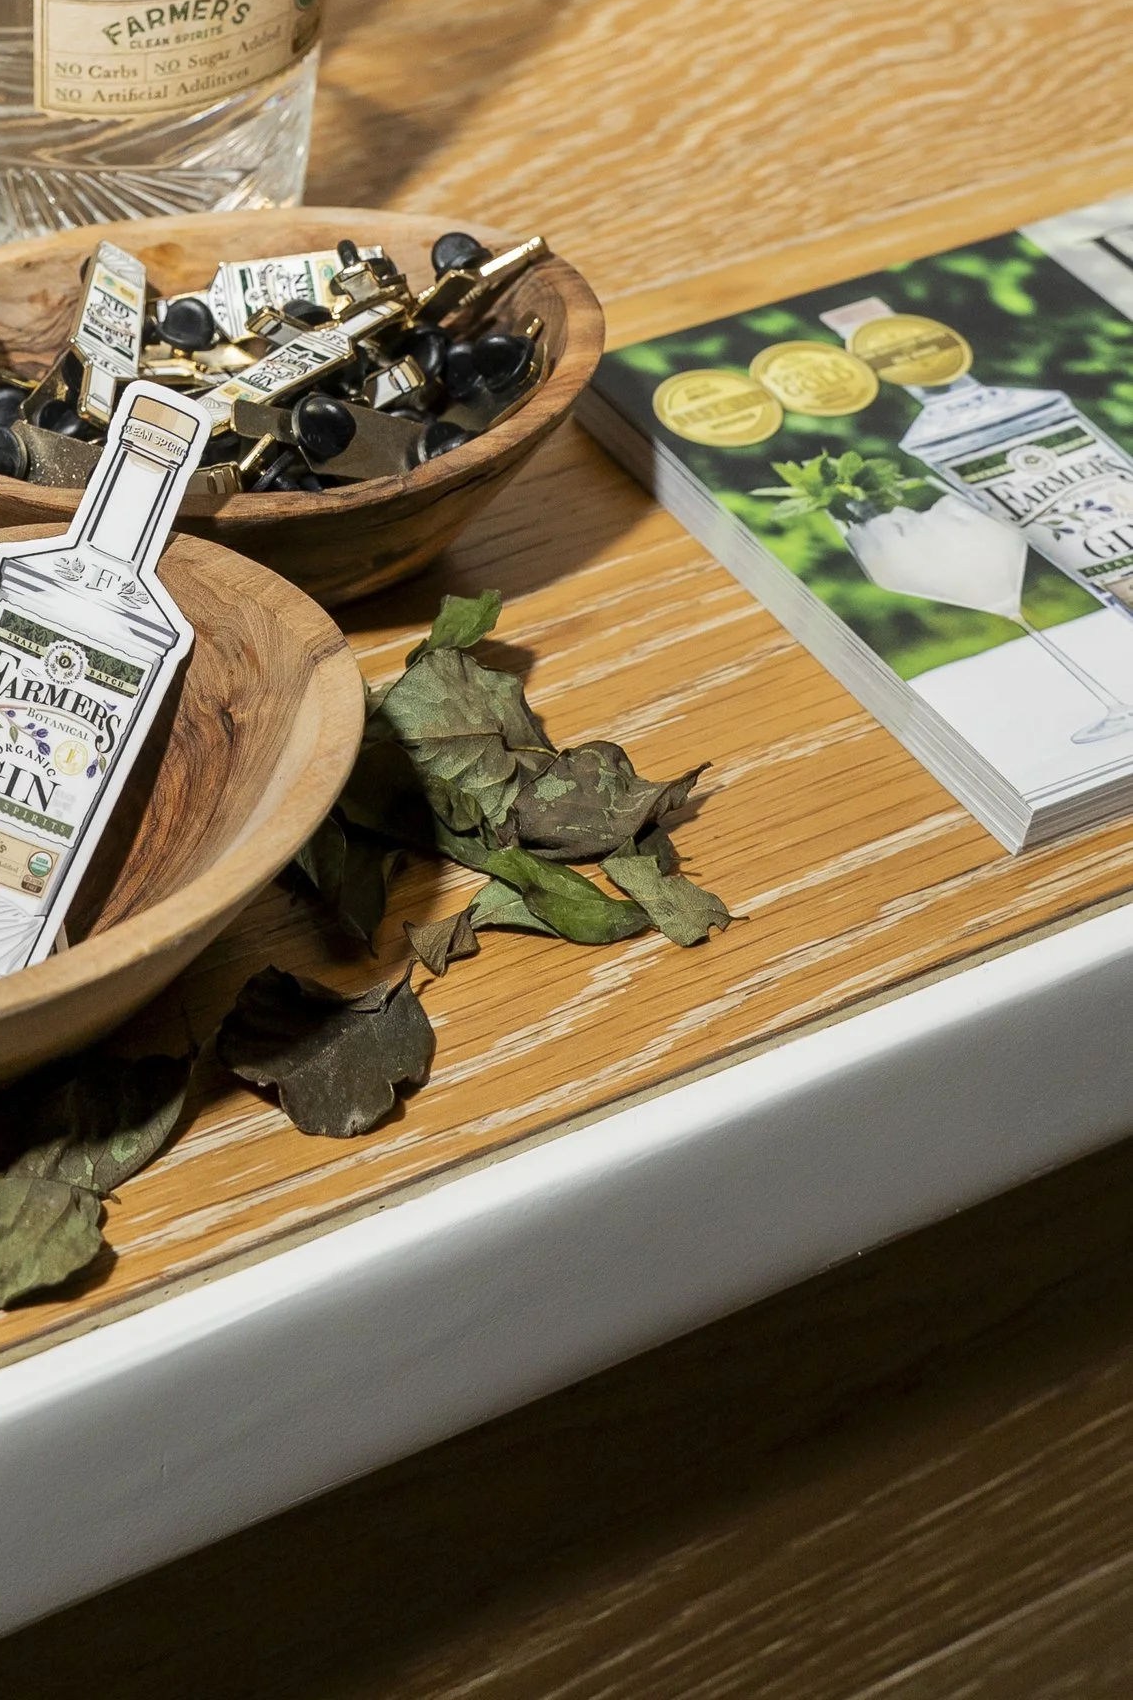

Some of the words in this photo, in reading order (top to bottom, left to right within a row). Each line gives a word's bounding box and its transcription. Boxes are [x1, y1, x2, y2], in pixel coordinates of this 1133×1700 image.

[55, 62, 82, 77] NO
[88, 64, 139, 79] Carbs
[154, 59, 181, 77] NO
[188, 49, 230, 69] Sugar
[238, 25, 282, 55] Added
[55, 87, 82, 103] NO
[92, 84, 168, 103] Artificial
[176, 67, 249, 97] Additives
[8, 633, 41, 653] SMALL
[89, 669, 125, 688] BATCH
[26, 706, 89, 742] BOTANICAL
[2, 803, 66, 833] SPIRITS
